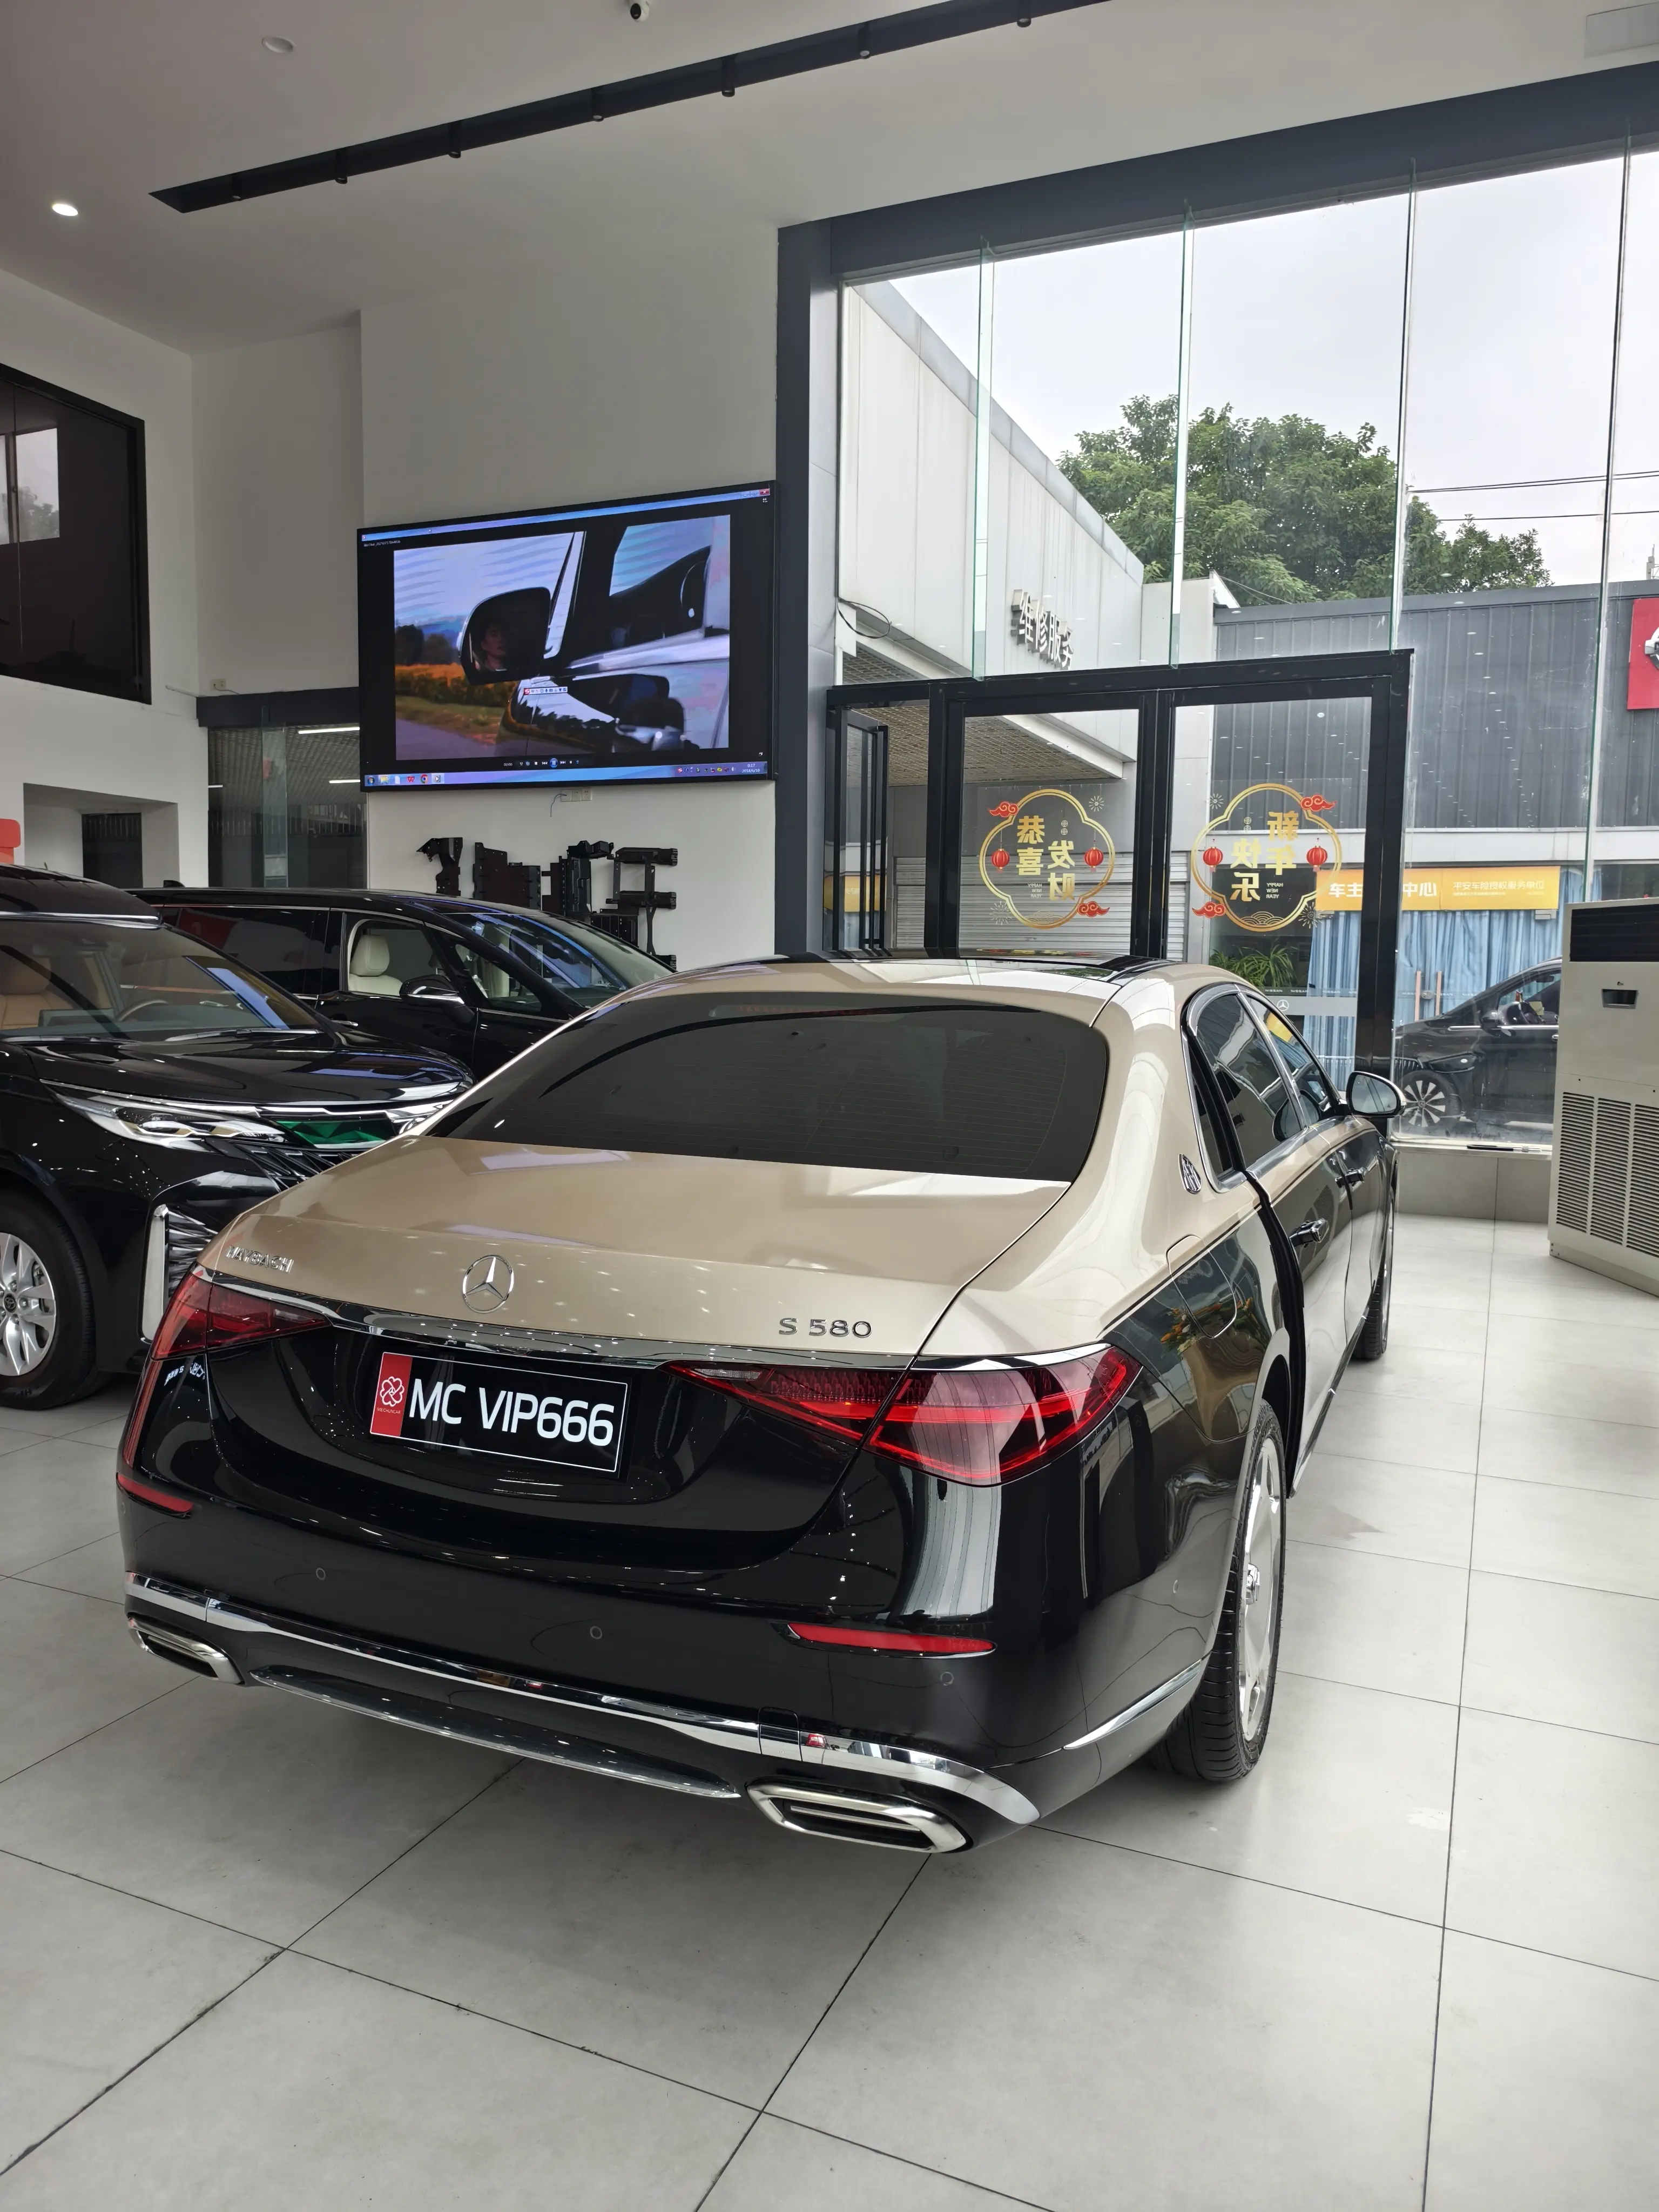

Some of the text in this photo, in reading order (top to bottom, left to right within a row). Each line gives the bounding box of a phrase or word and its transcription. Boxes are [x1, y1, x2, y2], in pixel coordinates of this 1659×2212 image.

[1012, 589, 1074, 670] 维修服务
[1453, 880, 1545, 890] 平安车险授权服务单位
[226, 1245, 294, 1273] MAYBACH
[779, 1317, 873, 1338] S 580
[409, 1378, 615, 1447] MC VIP666
